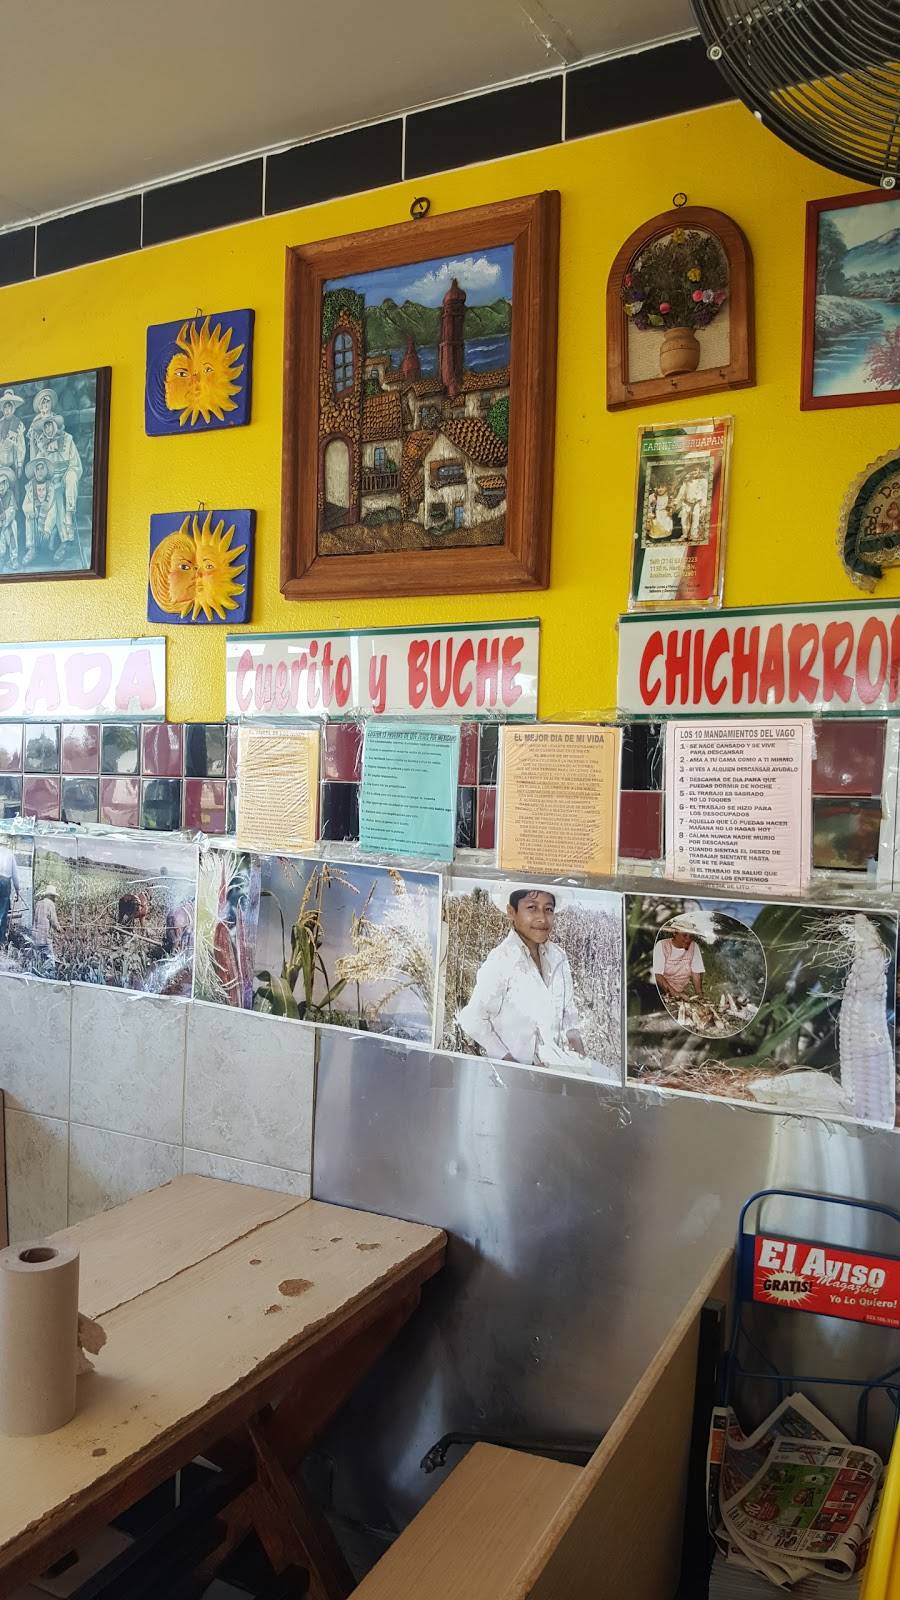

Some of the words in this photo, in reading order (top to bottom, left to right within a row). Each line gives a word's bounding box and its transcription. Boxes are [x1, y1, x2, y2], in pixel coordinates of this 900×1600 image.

[236, 640, 350, 712] Cuerito
[369, 654, 389, 714] y
[407, 635, 525, 709] BUCHE
[525, 734, 549, 742] MEJOR
[587, 735, 604, 743] VIDA
[704, 730, 758, 738] MANDAMIENTOS
[761, 729, 773, 737] DEL
[776, 729, 795, 737] VAGO
[763, 1279, 813, 1294] GRATIS!
[817, 1273, 879, 1295] Magazine
[830, 1295, 841, 1303] Yo
[844, 1296, 855, 1305] Lo
